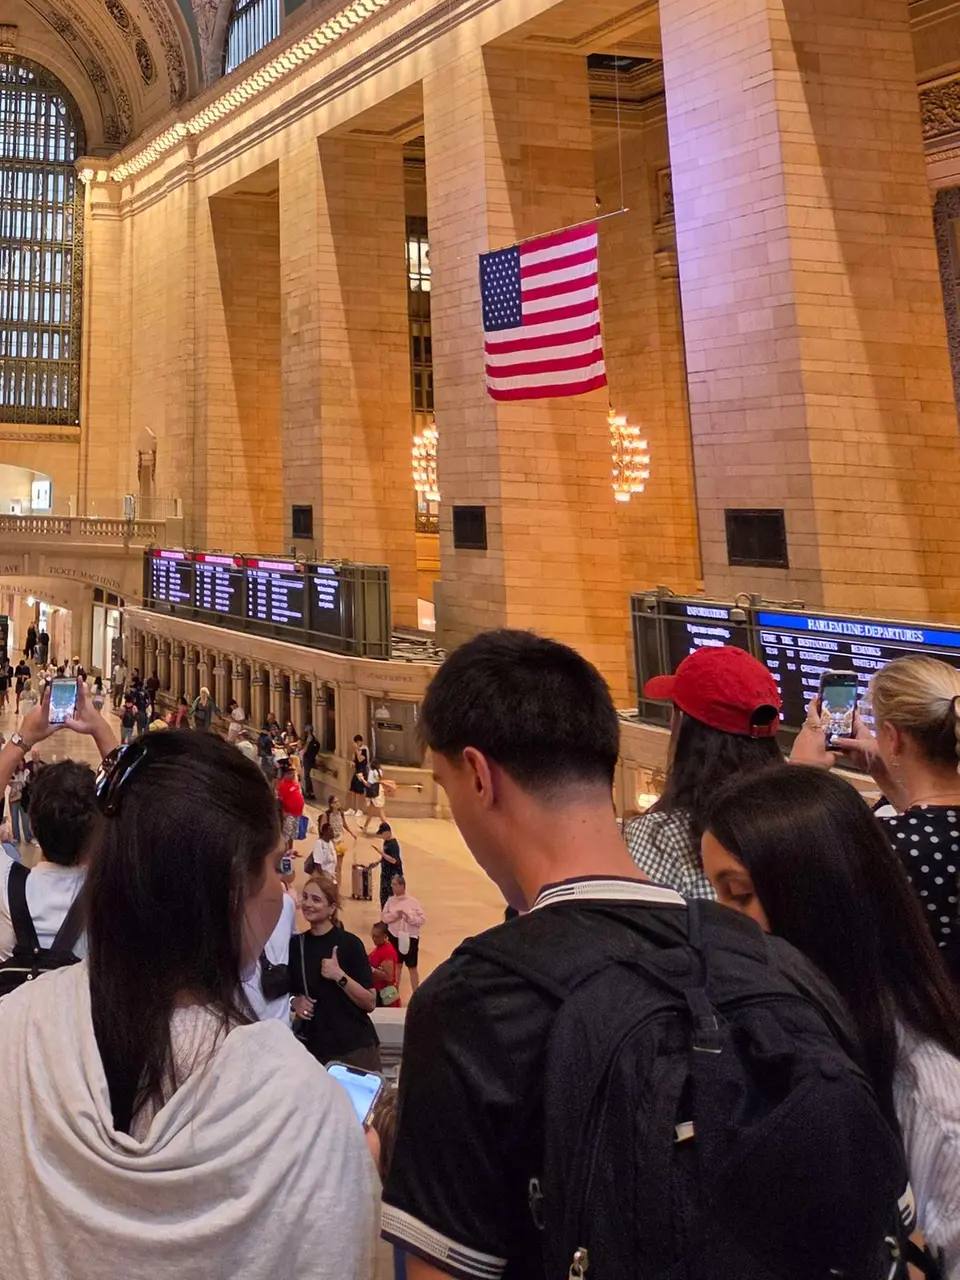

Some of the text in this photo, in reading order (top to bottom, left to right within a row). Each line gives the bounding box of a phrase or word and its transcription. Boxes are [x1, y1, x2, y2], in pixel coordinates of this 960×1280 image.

[48, 566, 121, 588] TICKET MACHINES
[808, 619, 924, 643] HARLEM LINE DEPARTURES
